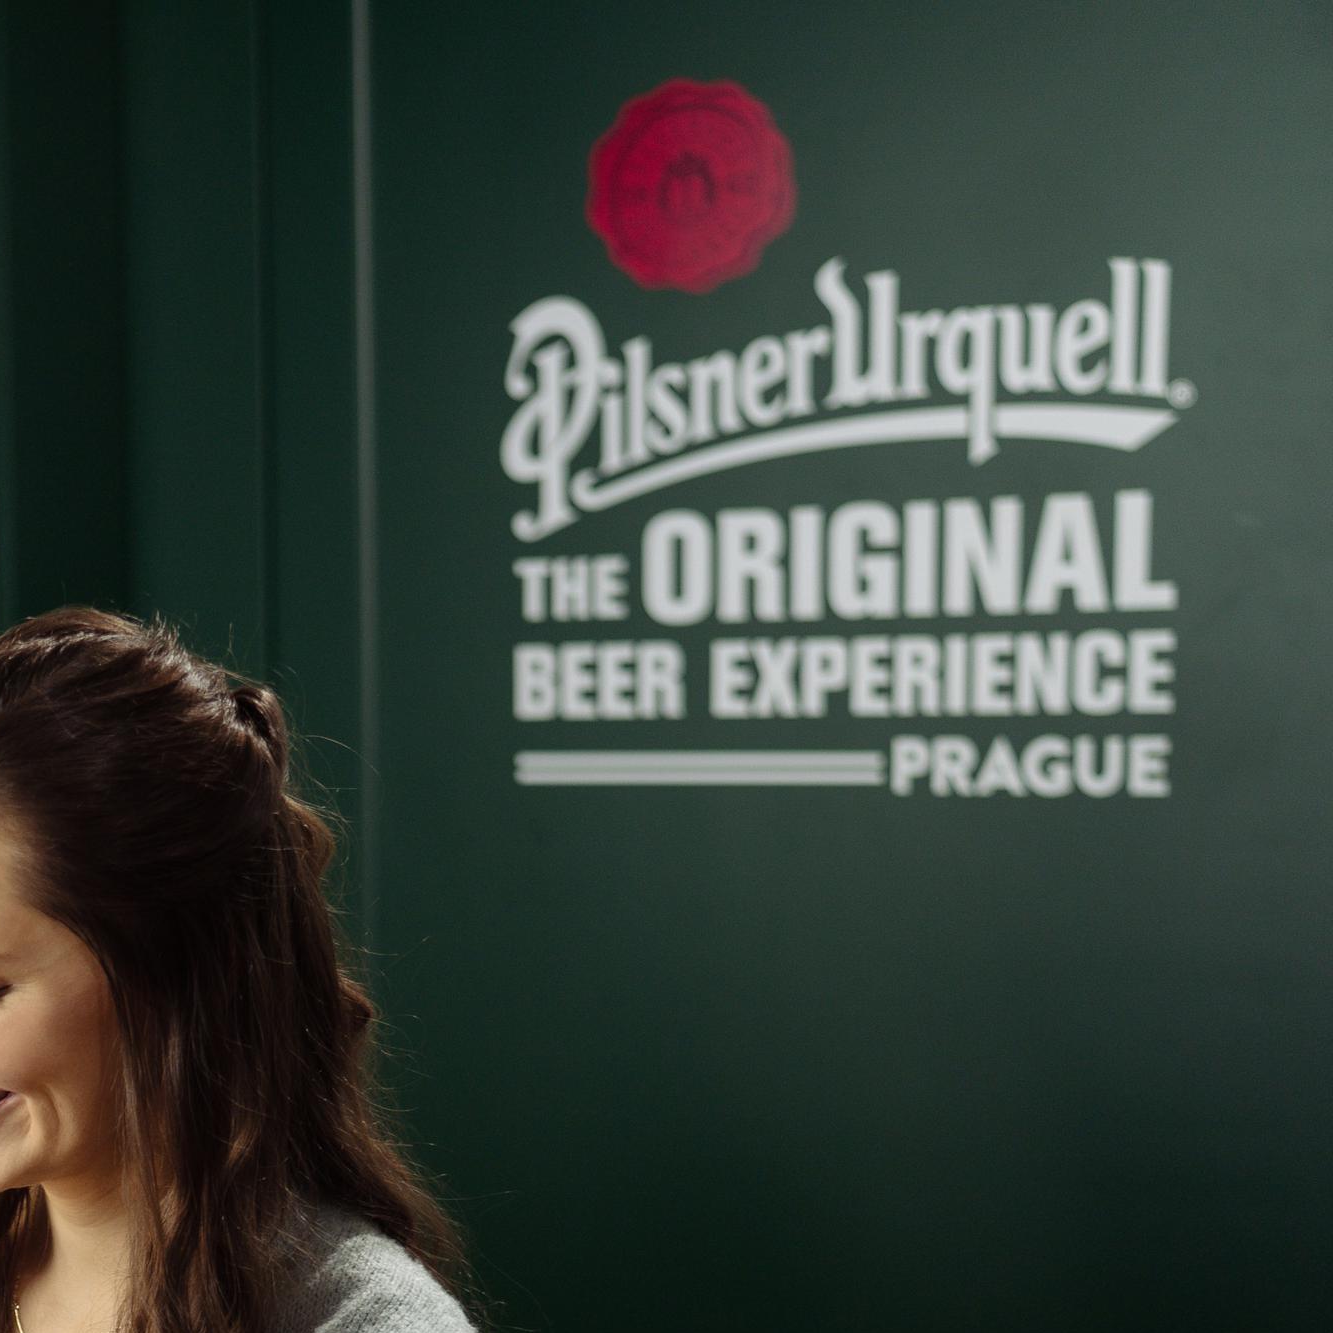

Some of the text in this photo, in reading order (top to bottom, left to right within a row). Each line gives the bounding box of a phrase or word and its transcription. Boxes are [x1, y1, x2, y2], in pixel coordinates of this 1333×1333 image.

[501, 256, 1175, 541] Pilsner Urquell
[513, 489, 1178, 625] THE ORIGINAL
[513, 629, 1178, 721] BEER EXPERIENCE
[890, 734, 1172, 798] PRAGUE
